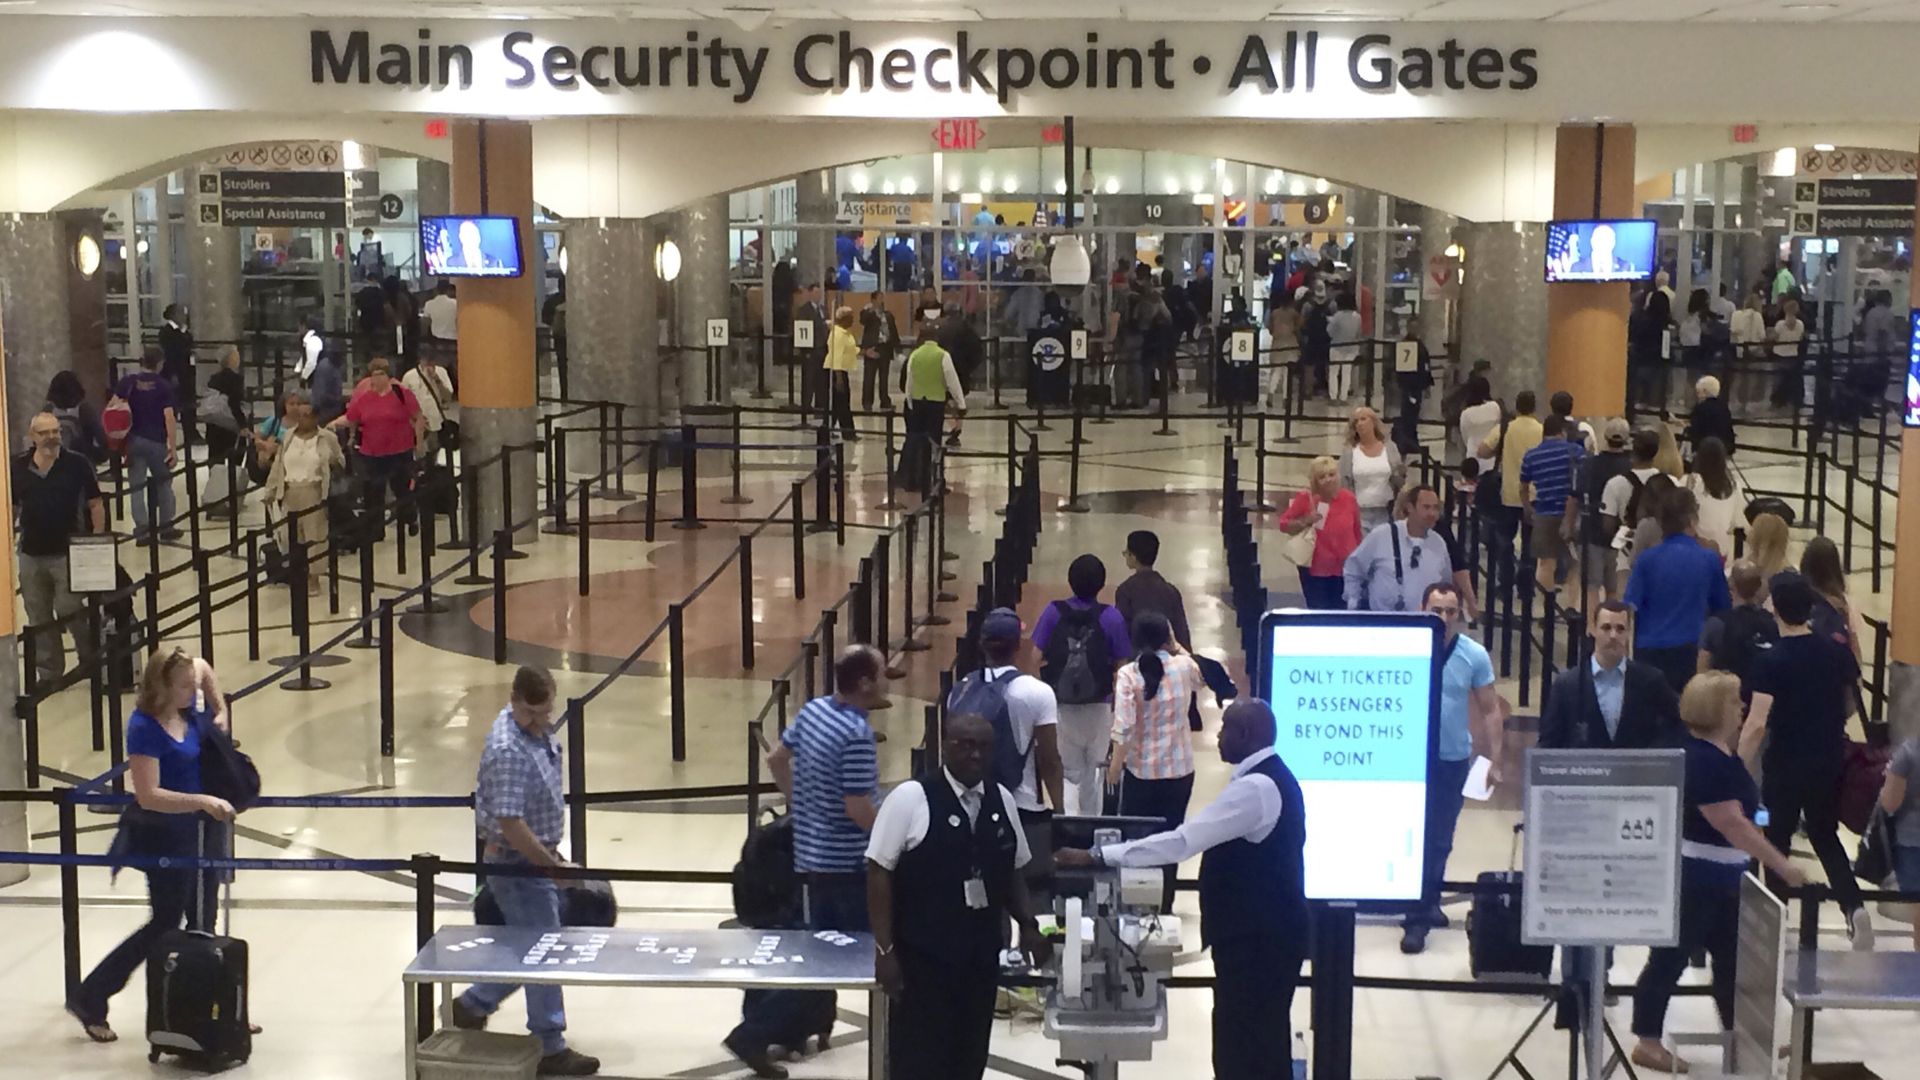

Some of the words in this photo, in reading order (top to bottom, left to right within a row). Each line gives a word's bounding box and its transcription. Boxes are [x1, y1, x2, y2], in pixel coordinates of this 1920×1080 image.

[310, 29, 473, 85] Main
[502, 30, 769, 103] Security
[794, 30, 1175, 104] Checkpoint
[1228, 31, 1318, 89] All
[1348, 34, 1538, 90] Gates
[939, 119, 979, 150] EXIT
[224, 178, 271, 191] Strollers
[1822, 185, 1872, 198] Strollers
[224, 207, 264, 221] Special
[267, 207, 326, 220] Assistance
[383, 201, 398, 214] 12
[843, 200, 912, 216] Assistance
[1146, 204, 1162, 218] 10
[1311, 205, 1321, 218] 9
[1820, 216, 1862, 230] Special
[1864, 217, 1916, 229] Assistan
[711, 326, 724, 338] 12
[798, 327, 808, 340] 11
[1075, 337, 1083, 351] 9
[1238, 339, 1247, 353] 8
[1403, 349, 1411, 363] 7
[1289, 668, 1335, 685] ONLY
[1341, 669, 1413, 686] TICKETED
[1297, 696, 1404, 713] PASSENGERS
[1294, 723, 1363, 740] BEYOND
[1370, 724, 1404, 740] THIS
[1322, 751, 1374, 767] POINT
